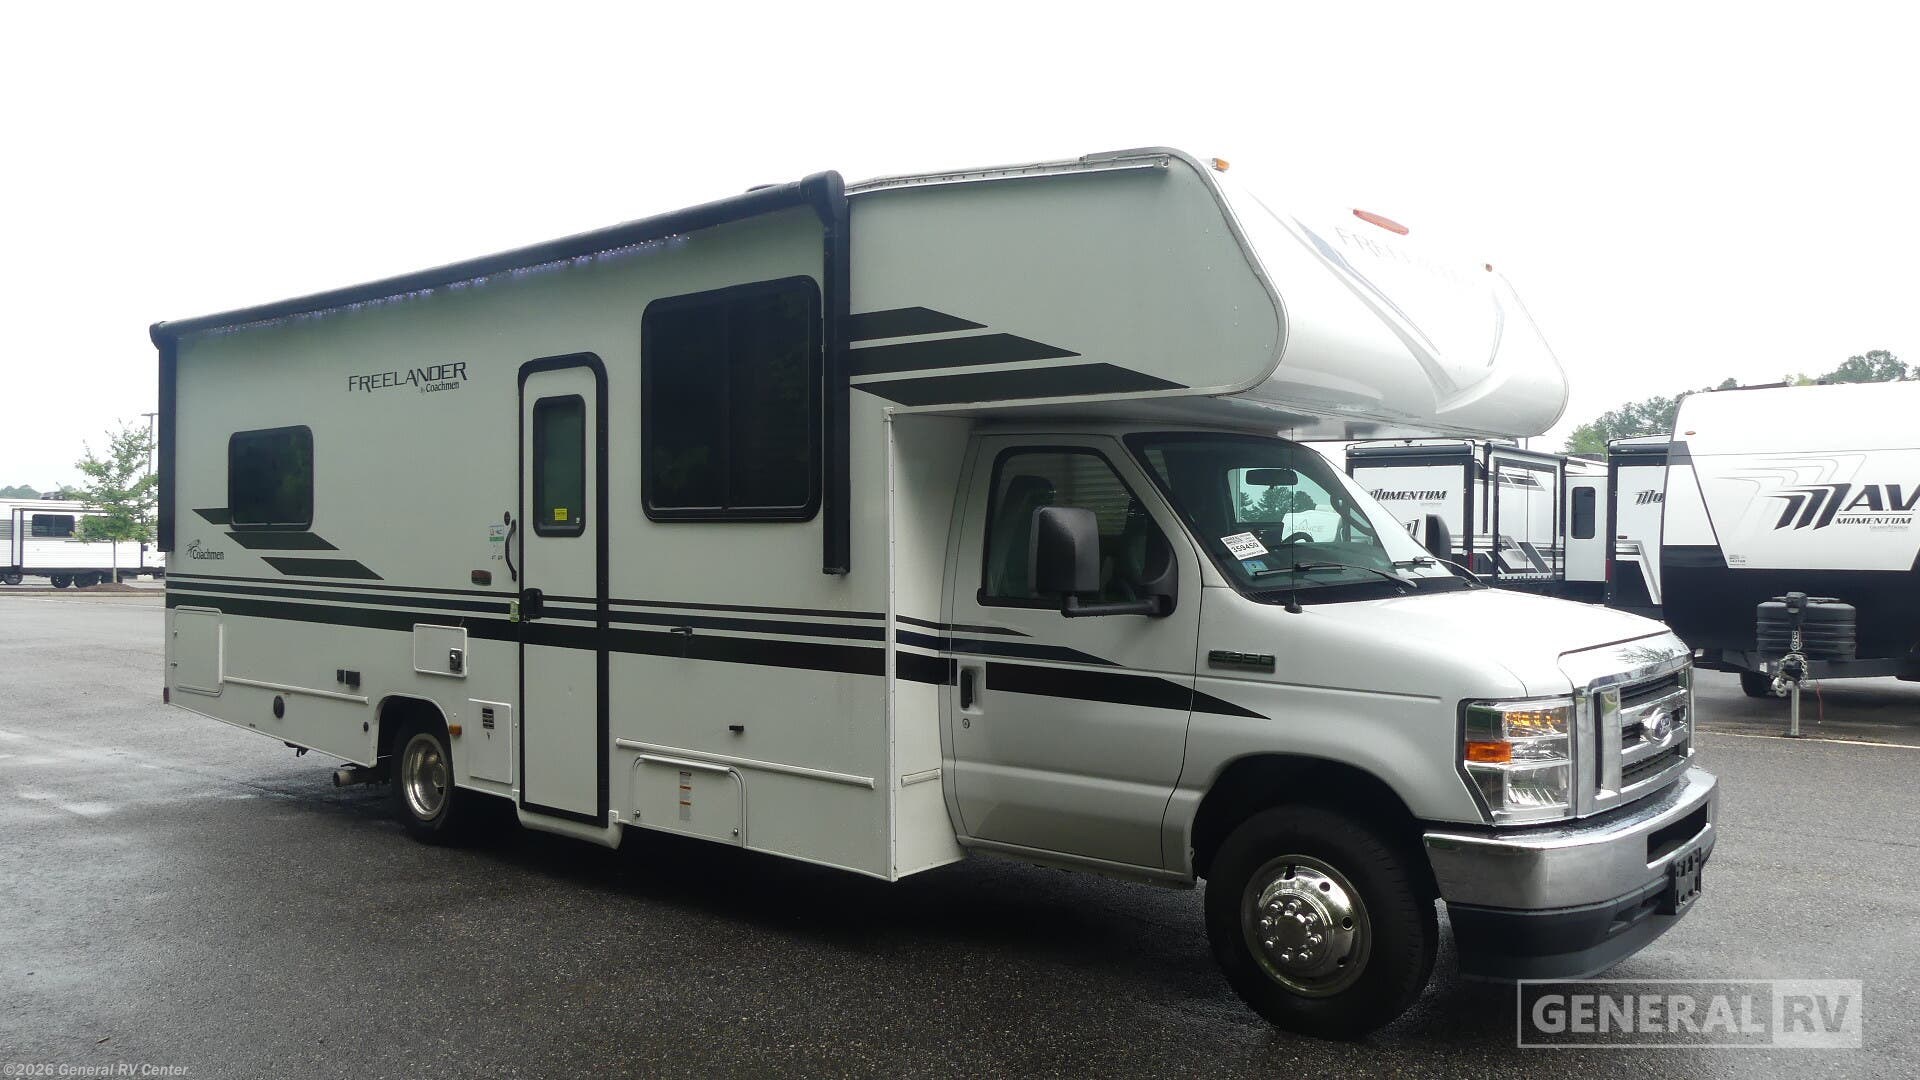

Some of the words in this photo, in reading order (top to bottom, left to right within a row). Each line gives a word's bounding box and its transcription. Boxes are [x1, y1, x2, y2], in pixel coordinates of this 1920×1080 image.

[348, 361, 467, 392] FREELANDER
[426, 381, 460, 393] Coachmen
[1369, 488, 1448, 502] MOMENTUM
[1836, 517, 1912, 525] MOMENTUM
[192, 548, 225, 560] Coachmen
